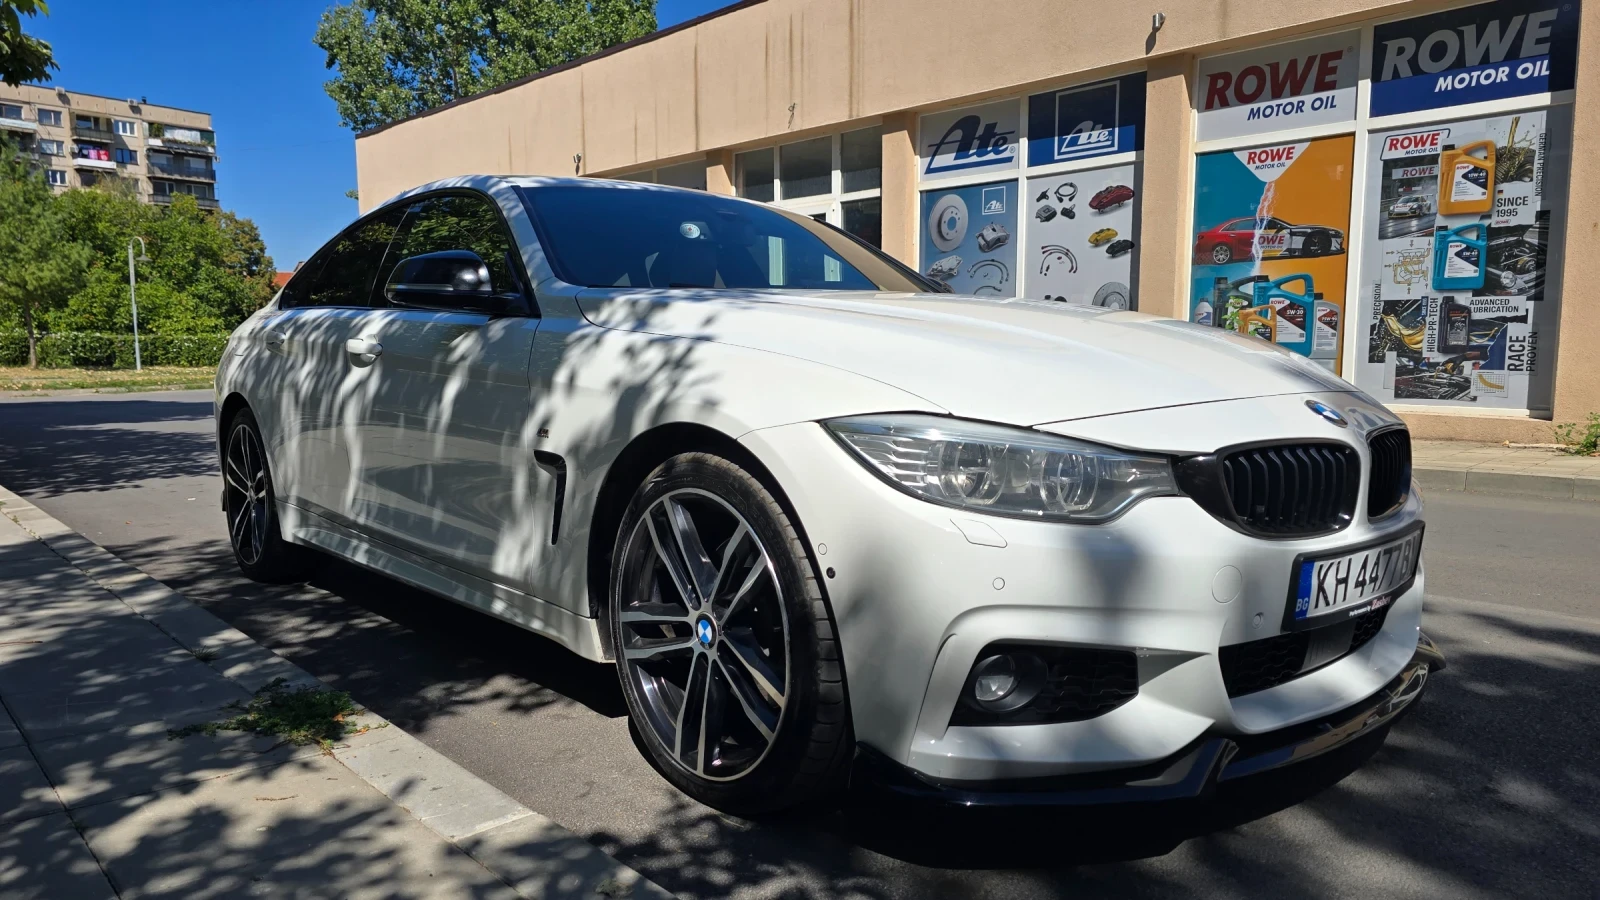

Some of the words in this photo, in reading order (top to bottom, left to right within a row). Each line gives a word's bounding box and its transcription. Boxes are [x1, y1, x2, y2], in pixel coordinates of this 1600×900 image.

[1381, 8, 1558, 81] ROWE
[1205, 49, 1344, 110] ROWE
[1434, 66, 1509, 93] MOTOR
[1515, 59, 1551, 80] OIL
[1247, 100, 1305, 121] MOTOR
[1311, 95, 1337, 112] OIL
[924, 114, 1015, 174] Ate
[1060, 120, 1112, 153] Ate
[1388, 132, 1441, 151] ROWE
[1538, 133, 1547, 161] GERMAN
[1247, 146, 1295, 165] ROWE
[1404, 148, 1427, 156] MOTOR
[1254, 163, 1276, 171] MOTOR
[1401, 166, 1435, 178] ROWE
[1535, 162, 1544, 197] PRECISION
[1496, 196, 1529, 208] SINCE
[1496, 209, 1518, 217] 1995
[1258, 235, 1285, 245] OWE
[1373, 283, 1382, 320] PRECISION
[1469, 298, 1510, 306] ADVANCED
[1426, 297, 1439, 353] HIGH-PR-TECH
[1507, 335, 1526, 372] RACE
[1526, 331, 1538, 372] PROVEN
[1313, 558, 1352, 609] KH
[1296, 597, 1309, 612] BG
